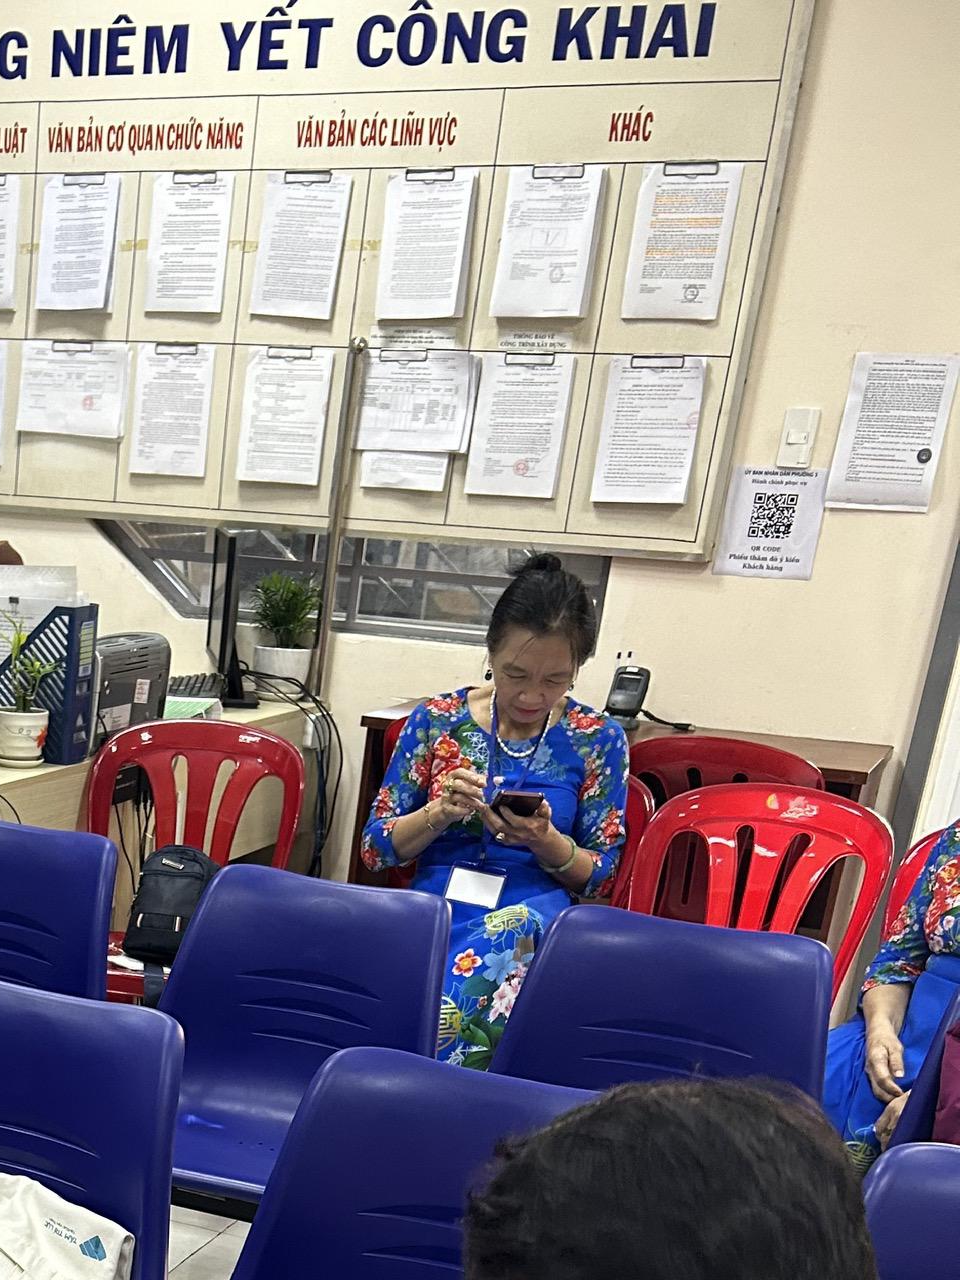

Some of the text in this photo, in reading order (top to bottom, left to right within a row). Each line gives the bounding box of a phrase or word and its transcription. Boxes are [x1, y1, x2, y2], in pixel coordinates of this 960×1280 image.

[51, 14, 189, 77] NIÊM
[220, 0, 333, 71] YẾT
[357, 0, 527, 67] CÔNG
[552, 3, 716, 60] KHAI
[48, 116, 243, 155] VĂN BẢN CƠ QUAN CHỨC NĂNG
[297, 116, 324, 147] VĂN
[328, 109, 356, 147] BẢN
[360, 112, 387, 146] CÁC
[429, 112, 457, 152] VỰC
[609, 105, 654, 142] KHÁC
